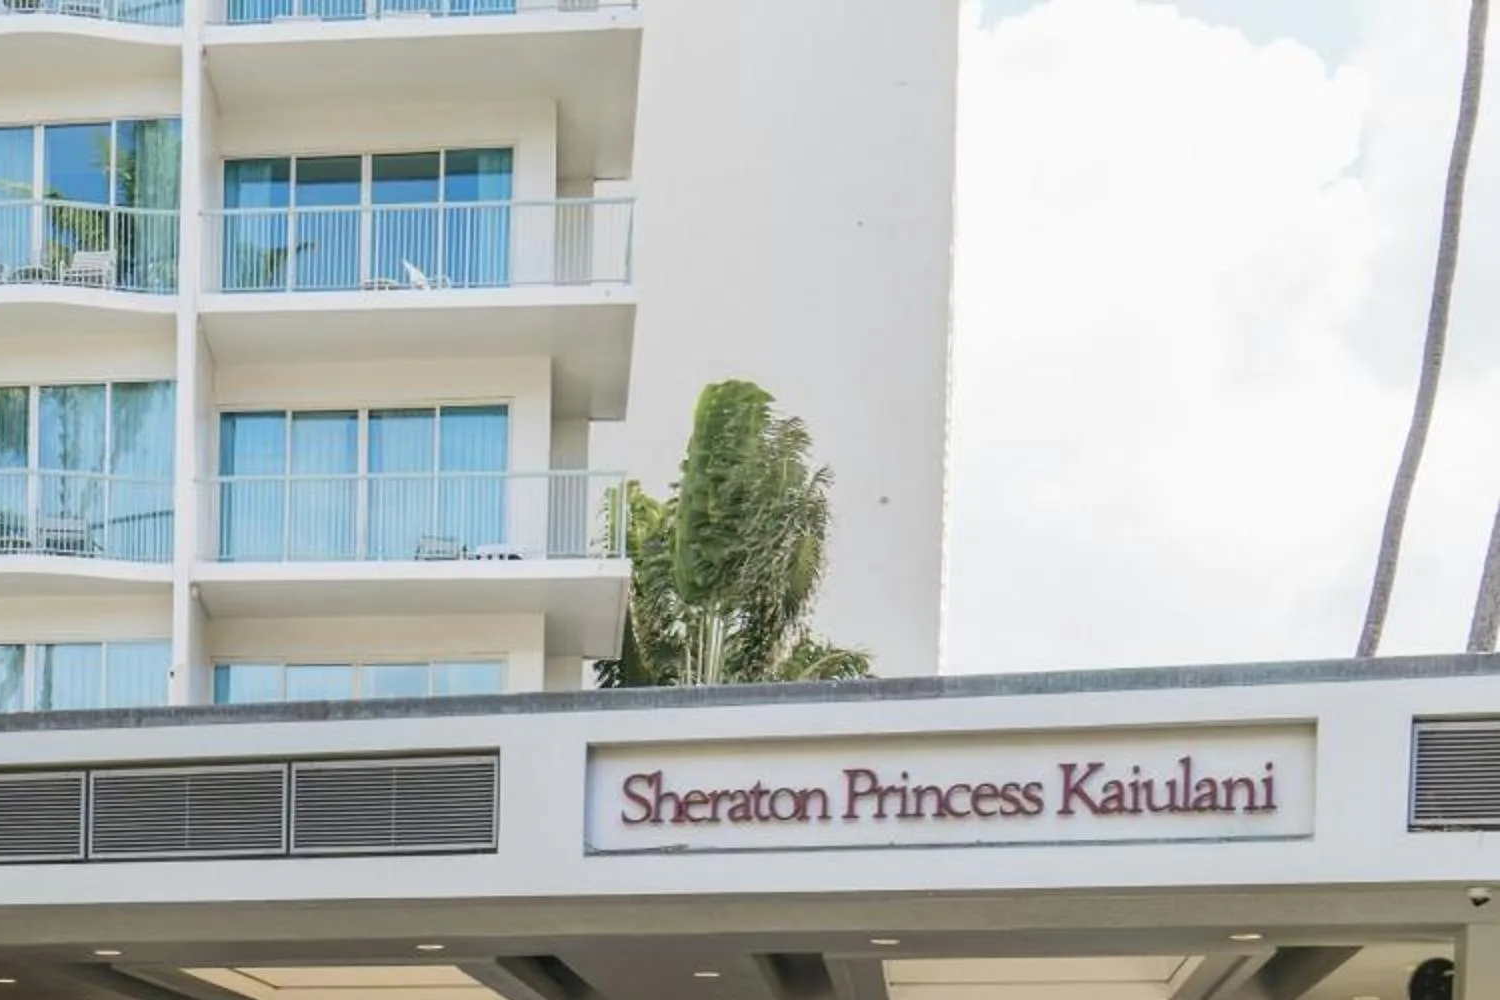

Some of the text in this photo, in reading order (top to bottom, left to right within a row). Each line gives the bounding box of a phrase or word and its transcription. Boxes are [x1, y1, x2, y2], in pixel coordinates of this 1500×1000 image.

[621, 756, 1277, 824] Sheraton Princess Kaiulani
